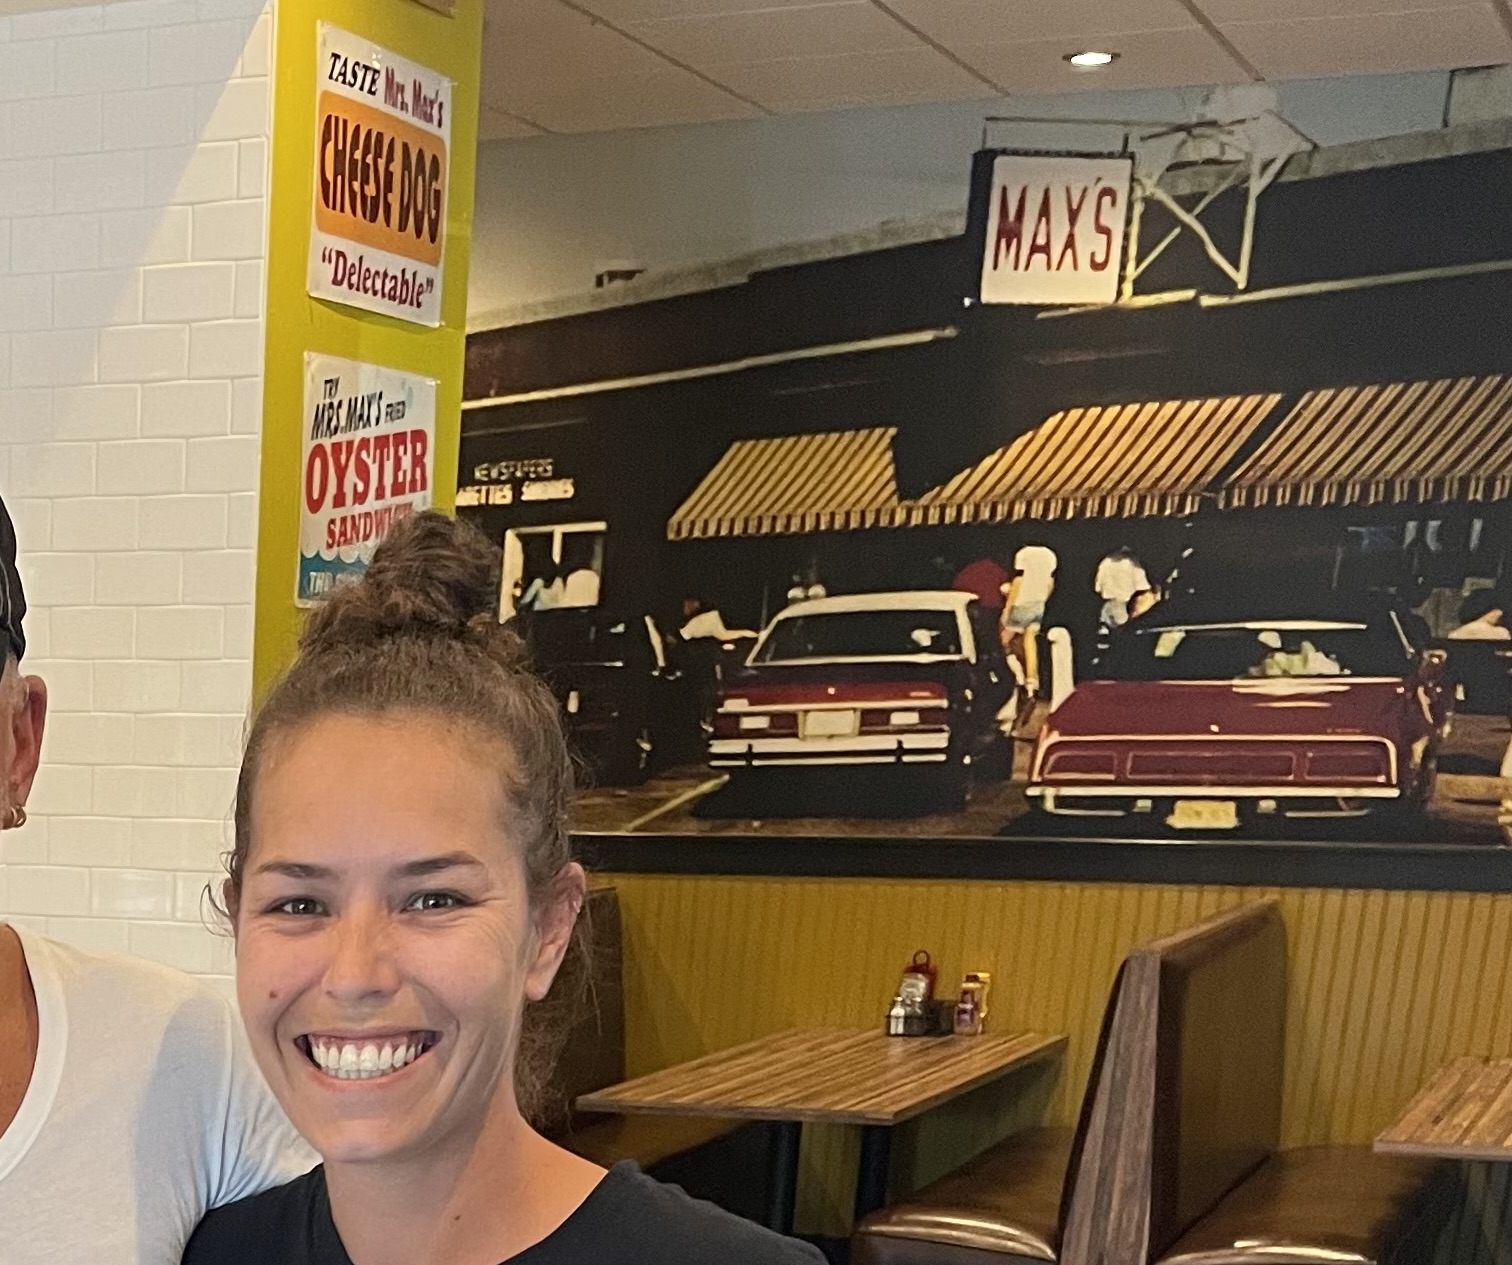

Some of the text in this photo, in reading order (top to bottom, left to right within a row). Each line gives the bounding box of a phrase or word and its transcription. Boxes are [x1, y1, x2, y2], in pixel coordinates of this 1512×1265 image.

[328, 52, 380, 96] TASTE
[320, 113, 441, 245] CHEESE DOG
[992, 176, 1117, 273] MAX'S
[323, 376, 340, 400] TRY
[305, 428, 428, 515] OYSTER
[325, 502, 413, 550] SANDW
